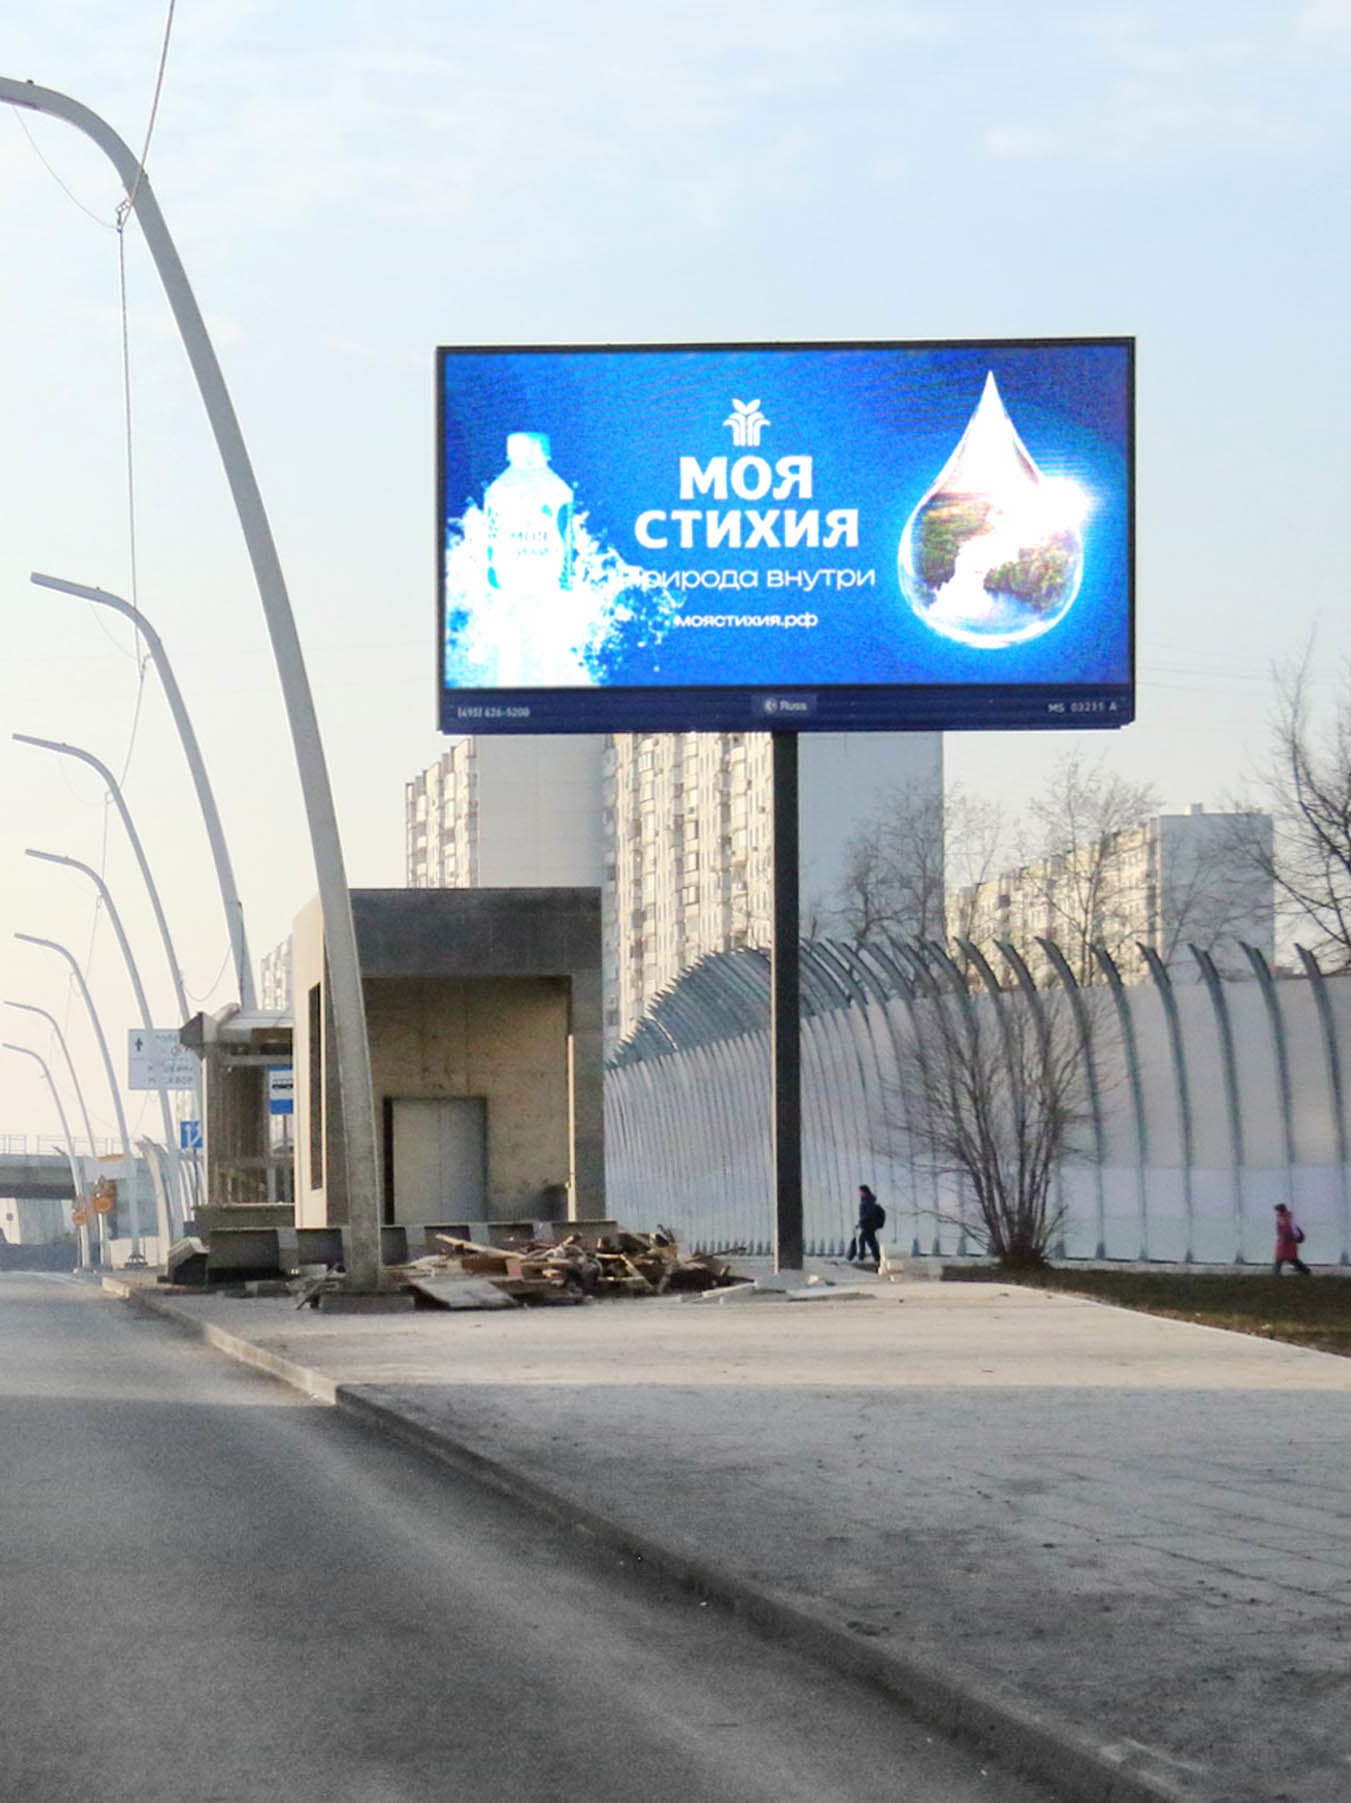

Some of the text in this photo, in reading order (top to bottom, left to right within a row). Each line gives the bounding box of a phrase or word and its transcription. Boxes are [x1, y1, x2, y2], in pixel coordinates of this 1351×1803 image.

[679, 456, 813, 500] МОЯ
[634, 509, 859, 549] СТИХИЯ
[624, 569, 876, 592] рирода внутри
[673, 612, 818, 628] моястихия.рф
